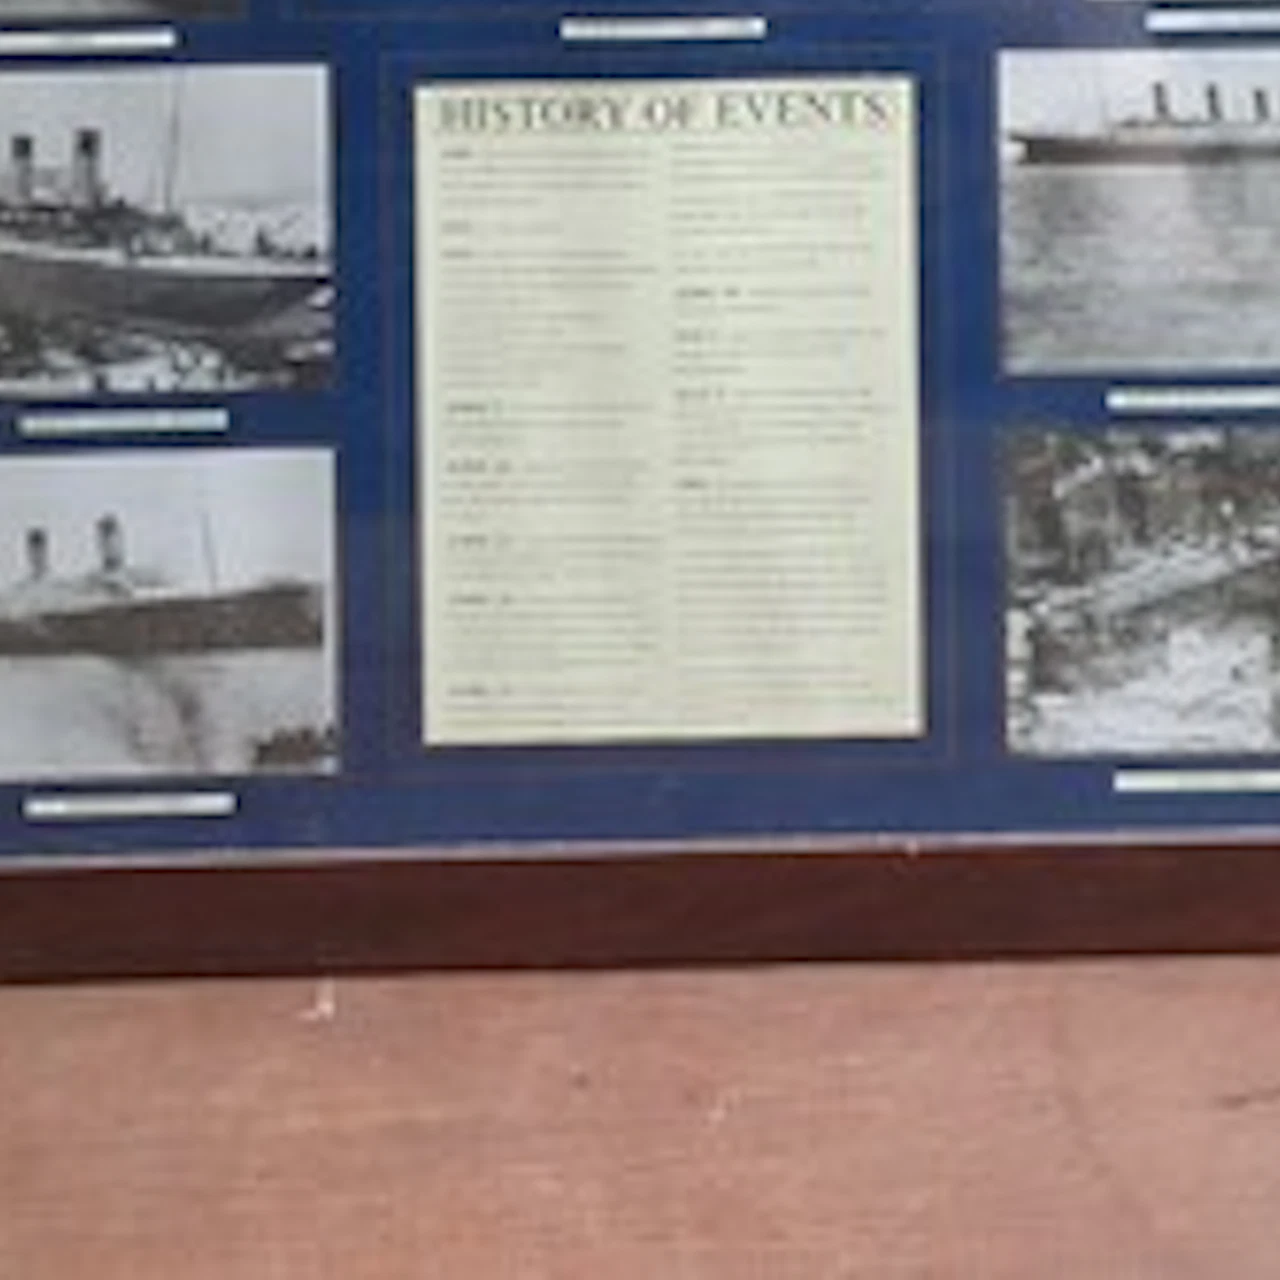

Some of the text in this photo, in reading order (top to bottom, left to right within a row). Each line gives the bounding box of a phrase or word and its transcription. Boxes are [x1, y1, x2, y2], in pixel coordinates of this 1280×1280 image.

[438, 88, 890, 134] HISTORY OF EVENTS
